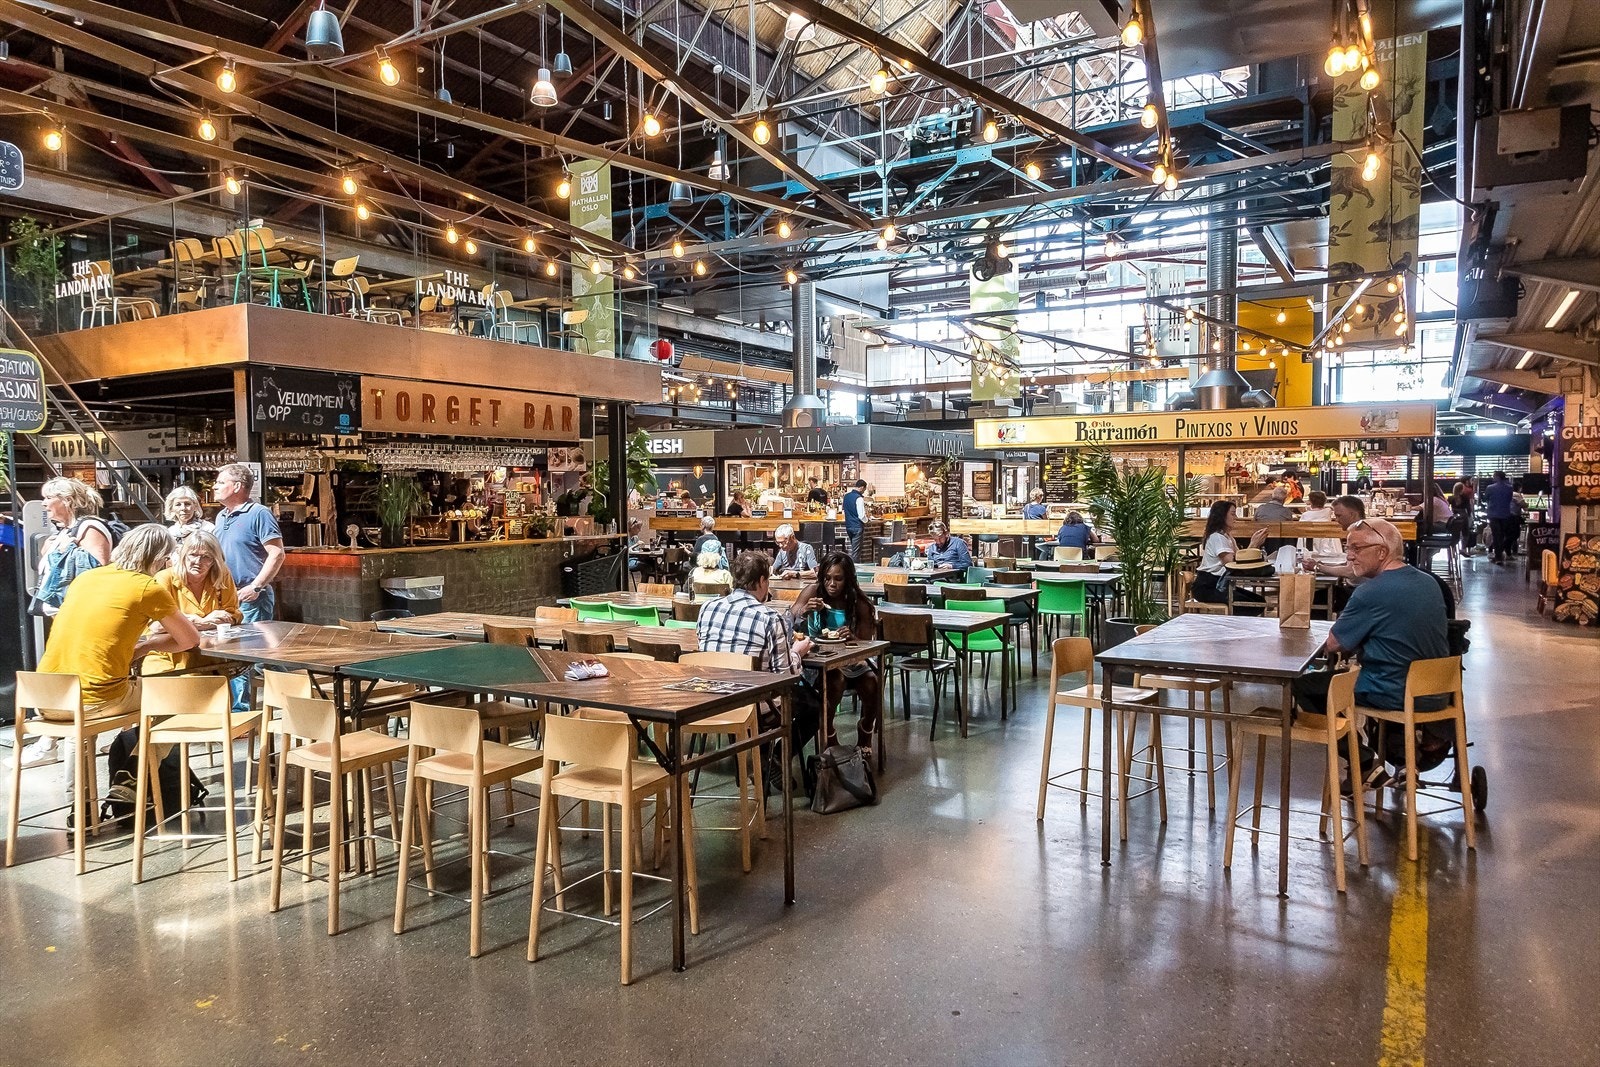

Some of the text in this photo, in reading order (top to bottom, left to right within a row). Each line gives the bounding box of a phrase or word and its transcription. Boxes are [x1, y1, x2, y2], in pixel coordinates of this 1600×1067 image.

[1374, 34, 1422, 51] ALLEN
[571, 193, 609, 207] MATHALLEN
[581, 203, 599, 212] OSLO
[72, 259, 91, 276] THE
[55, 273, 111, 299] LANDMARK
[445, 269, 470, 288] THE
[418, 279, 495, 307] LANDMARK
[0, 358, 35, 376] STATION
[277, 390, 344, 409] VELKOMMEN
[268, 404, 291, 421] OPP
[370, 388, 573, 432] TORGET BAR
[1074, 420, 1158, 441] Barramón
[1562, 426, 1600, 440] GULA
[637, 438, 684, 454] RESH
[745, 433, 834, 454] VIA ITALIA
[927, 438, 965, 456] VIA ITALIA
[1564, 474, 1600, 487] BURG
